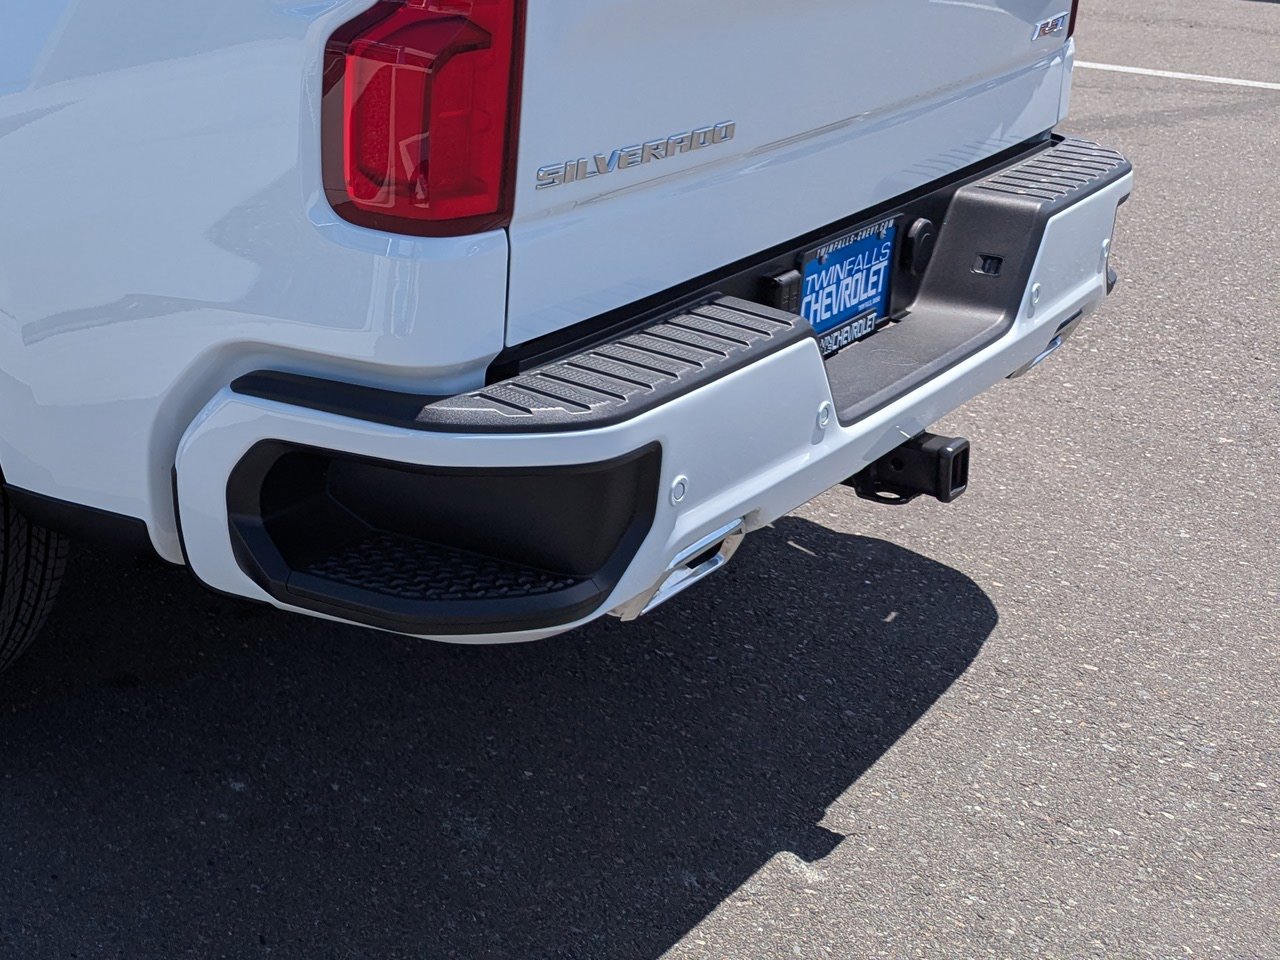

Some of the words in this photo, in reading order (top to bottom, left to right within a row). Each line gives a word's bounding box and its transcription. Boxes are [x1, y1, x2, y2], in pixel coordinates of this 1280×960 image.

[535, 119, 737, 191] SILVERADO
[800, 260, 888, 325] CHEVROLET
[831, 312, 877, 349] CHEVROLET
